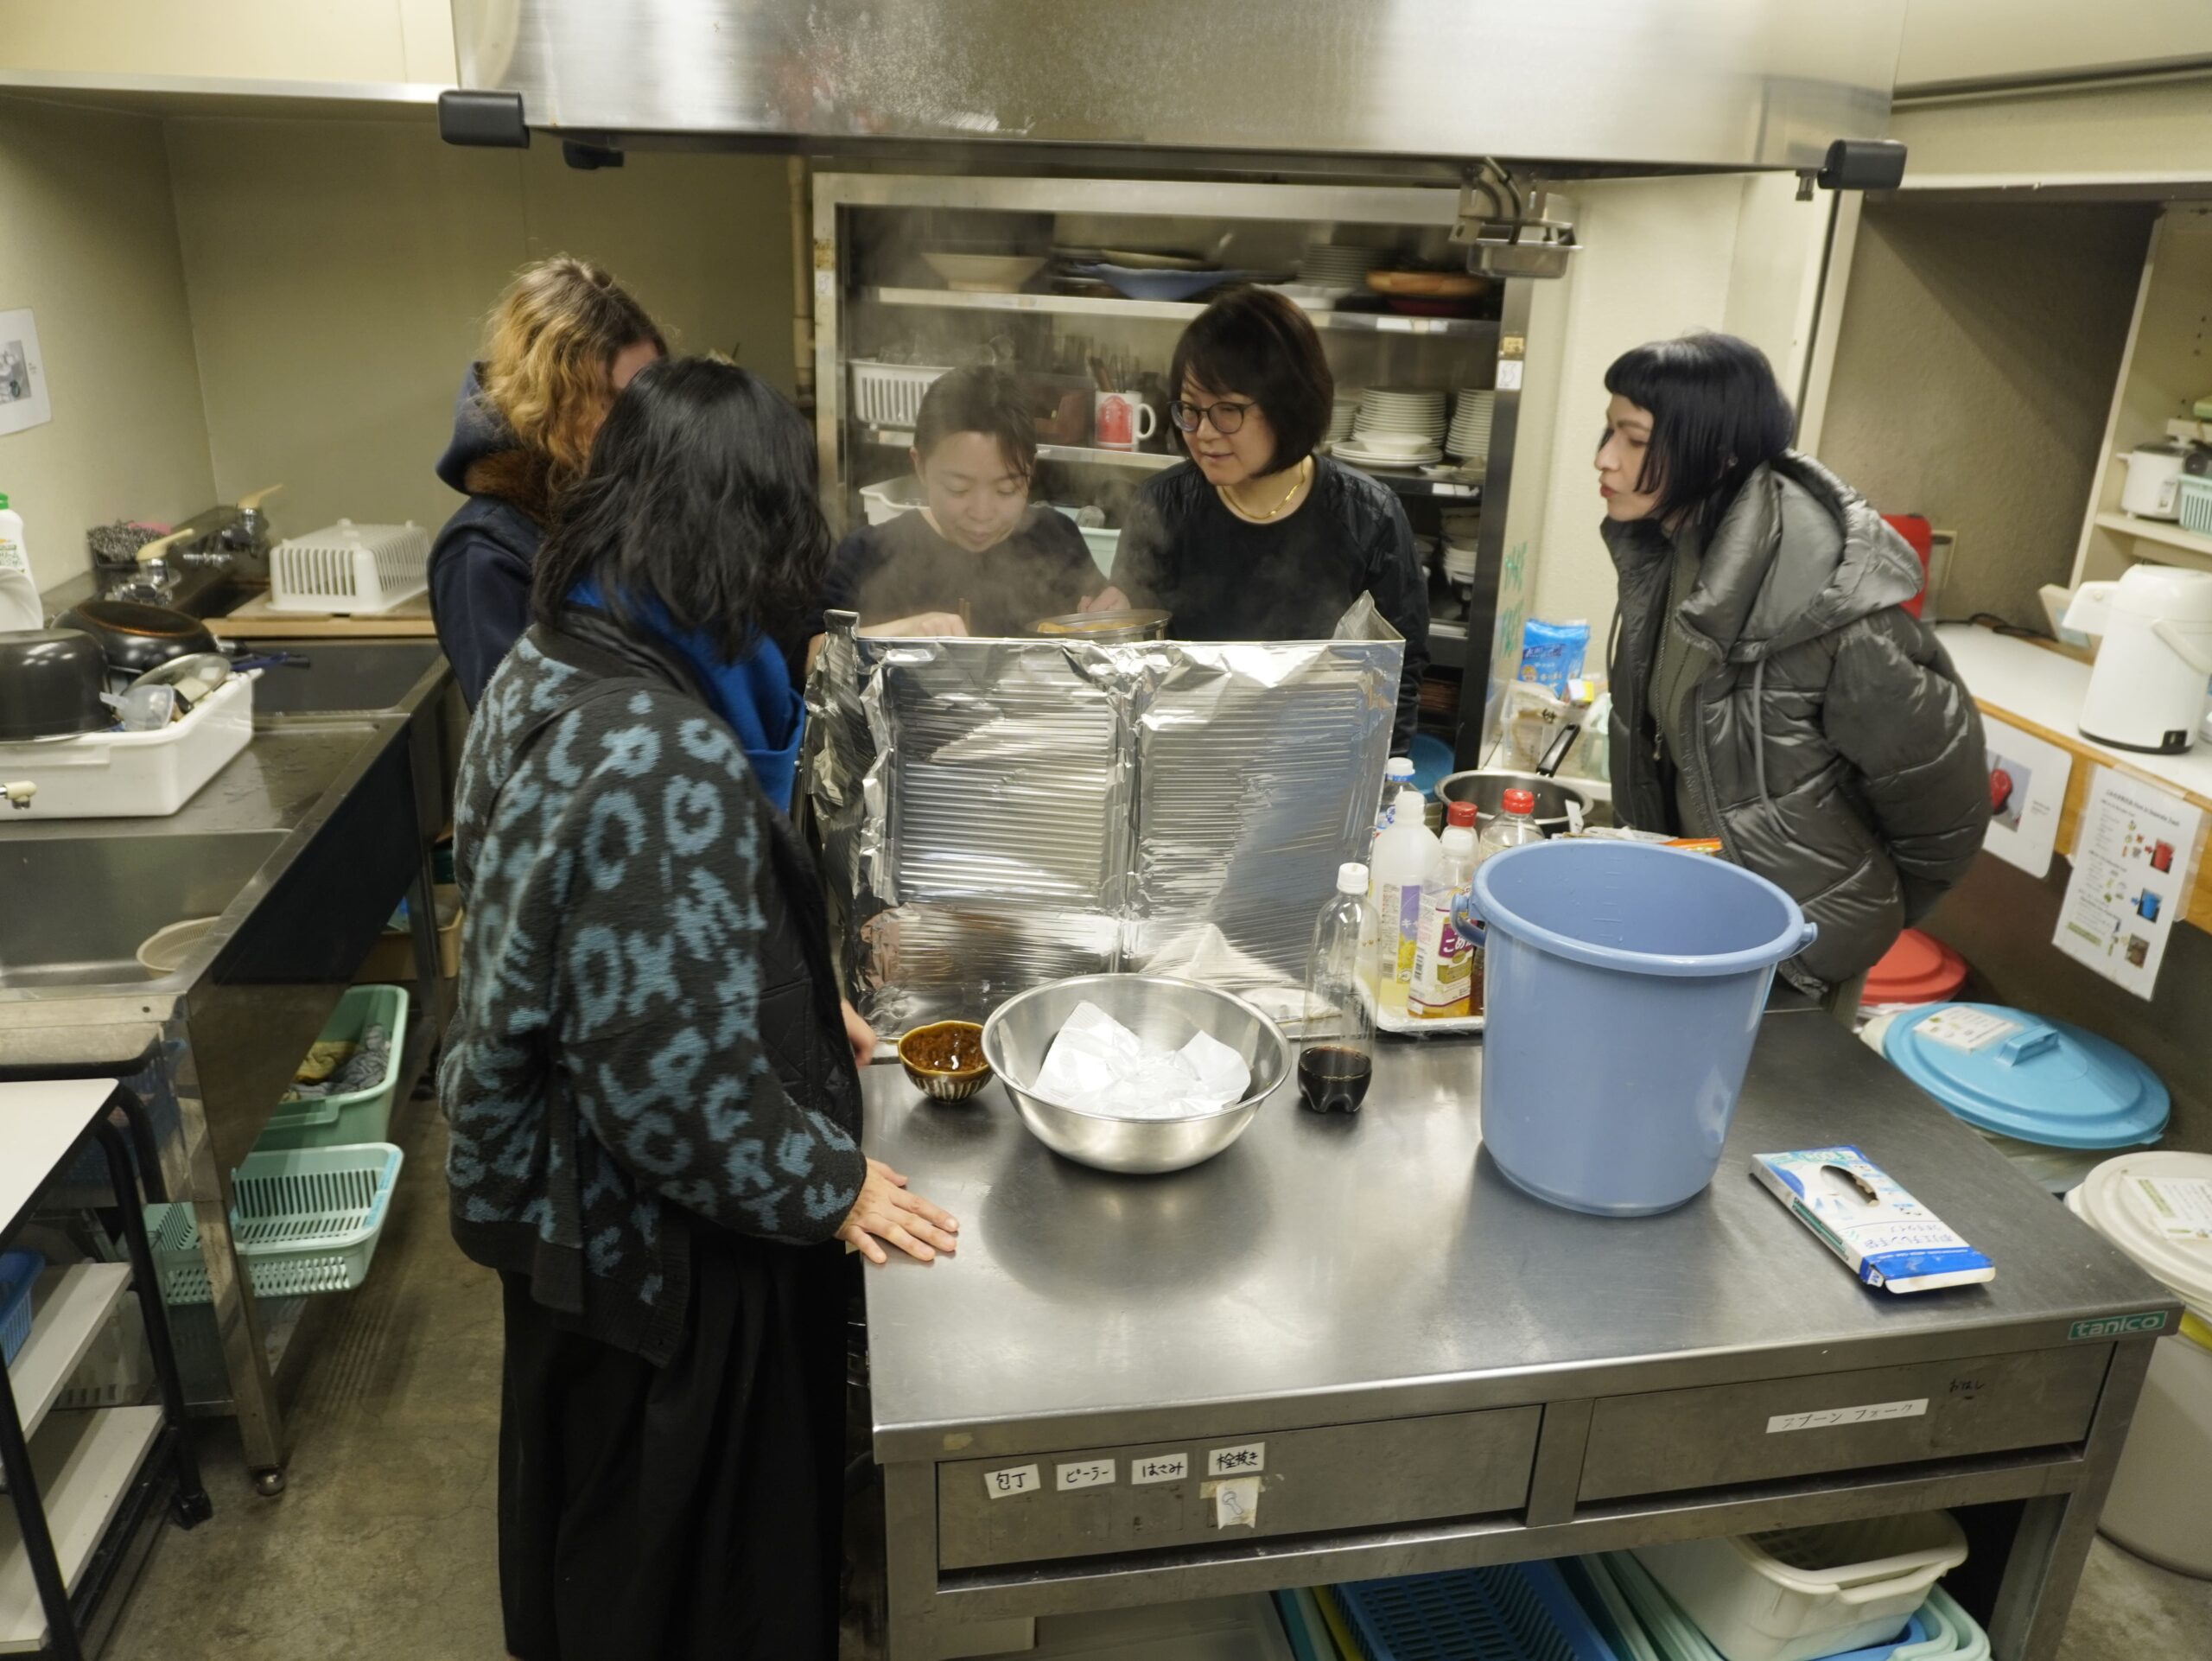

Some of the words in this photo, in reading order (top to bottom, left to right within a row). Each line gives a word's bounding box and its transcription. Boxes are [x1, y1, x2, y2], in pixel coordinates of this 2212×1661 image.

[2076, 1316, 2159, 1336] tanico
[1216, 1450, 1259, 1469] 栓抜き
[1065, 1467, 1109, 1483] ピーラー
[1142, 1461, 1185, 1478] はさみ
[996, 1472, 1027, 1490] 包丁
